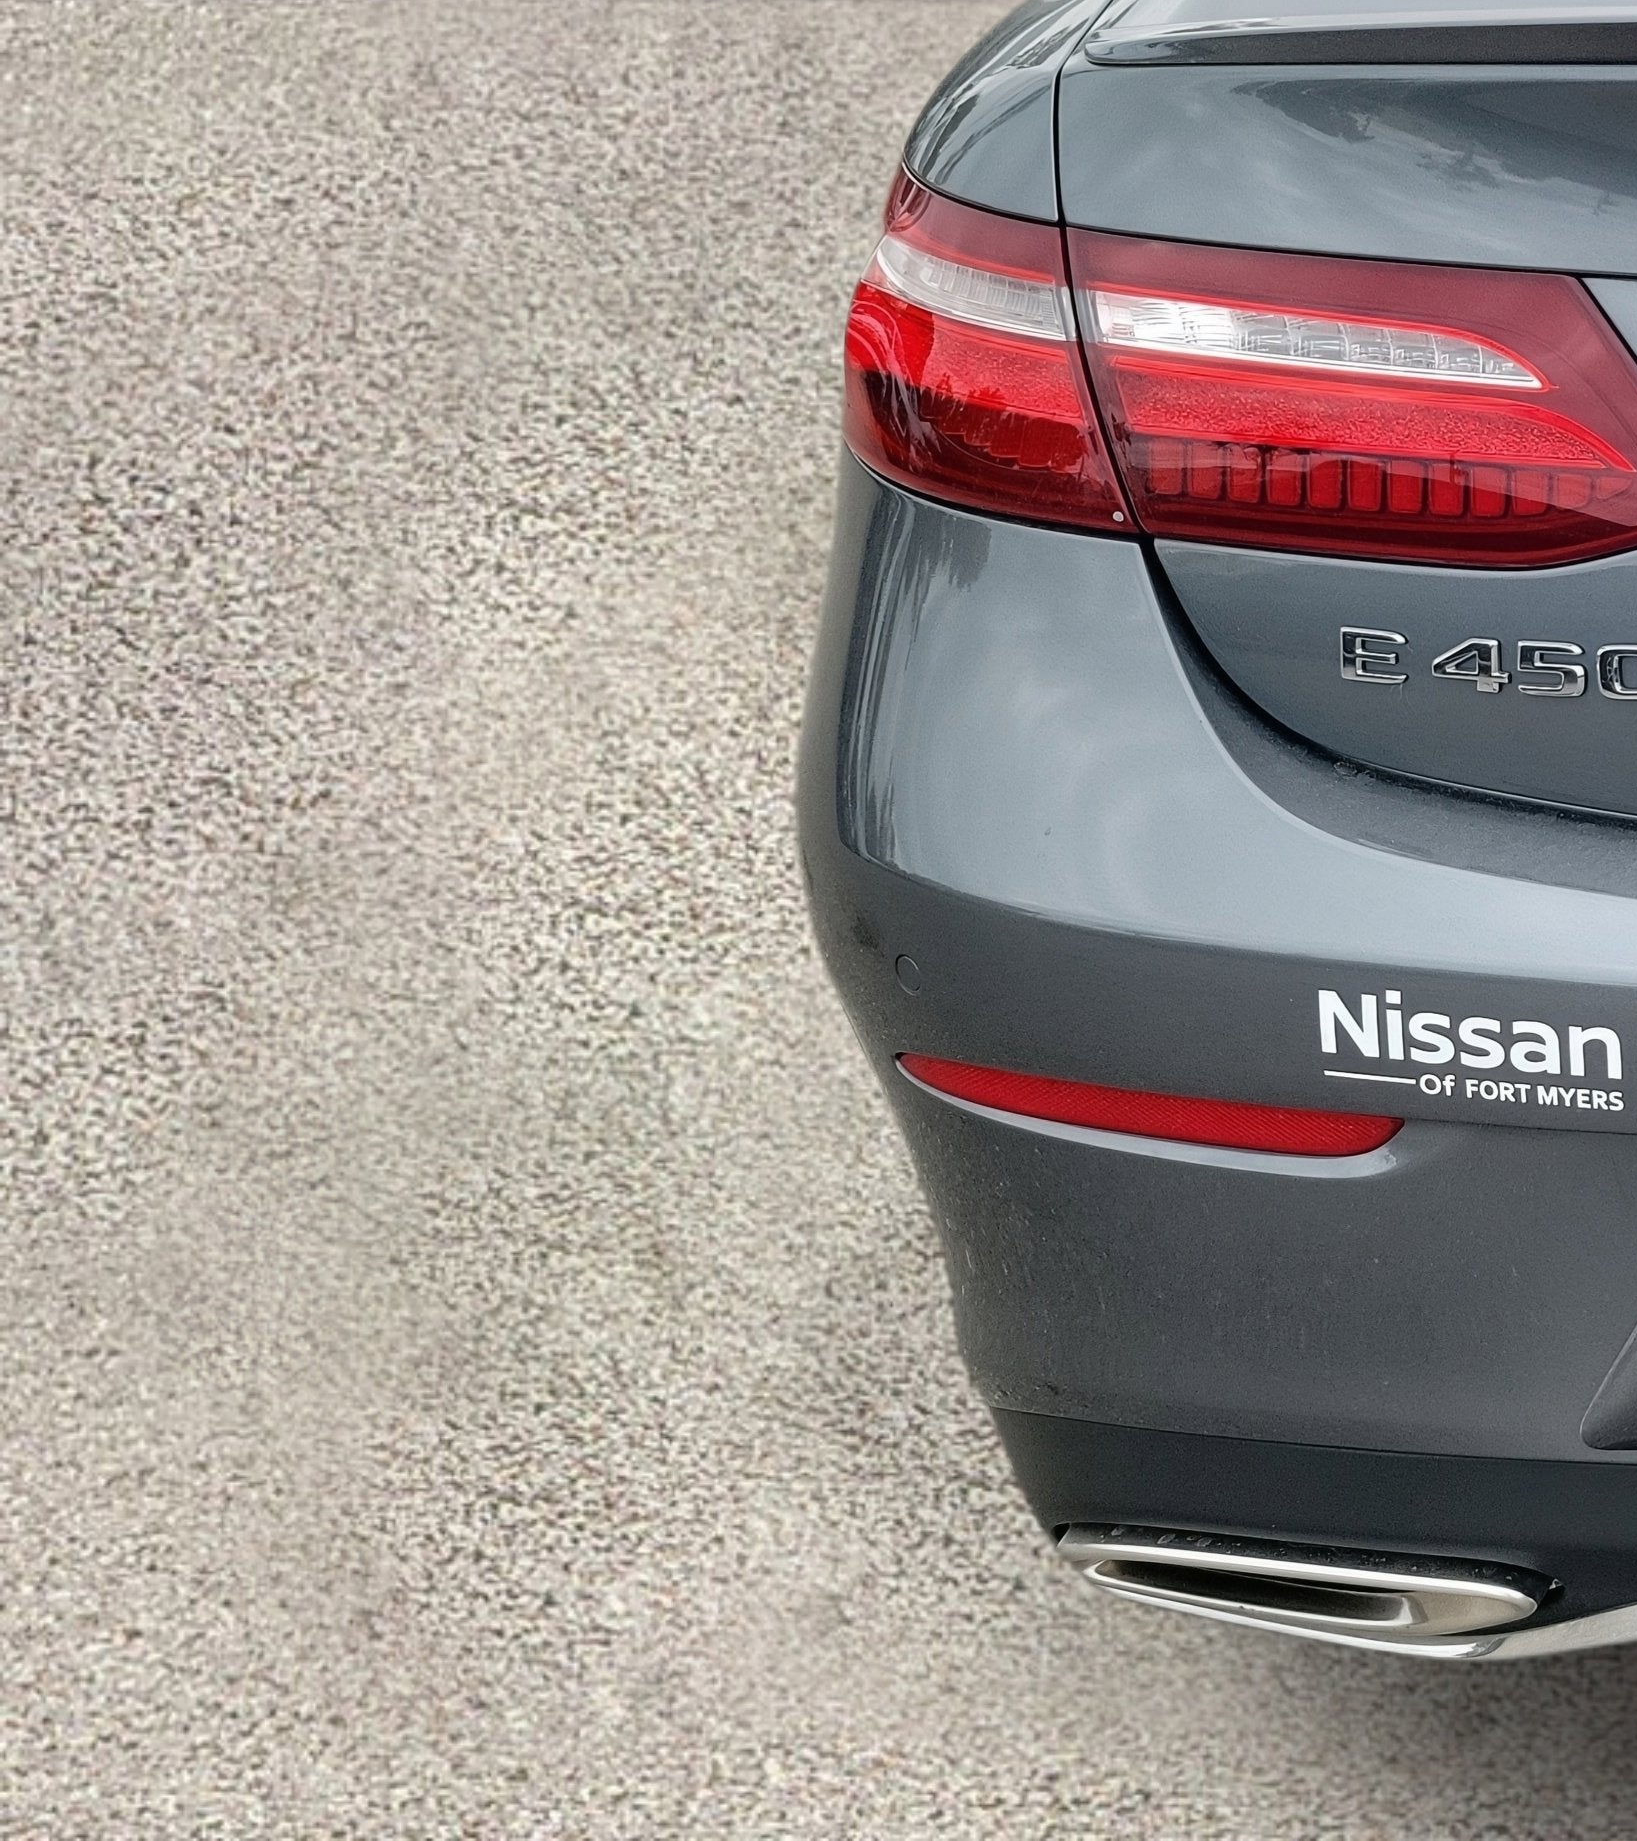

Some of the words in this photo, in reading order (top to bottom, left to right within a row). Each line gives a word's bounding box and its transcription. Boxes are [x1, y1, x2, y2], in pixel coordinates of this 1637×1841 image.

[1339, 626, 1408, 685] E
[1318, 989, 1623, 1080] Nissan
[1465, 1078, 1531, 1103] FORT
[1536, 1085, 1625, 1111] MYERS
